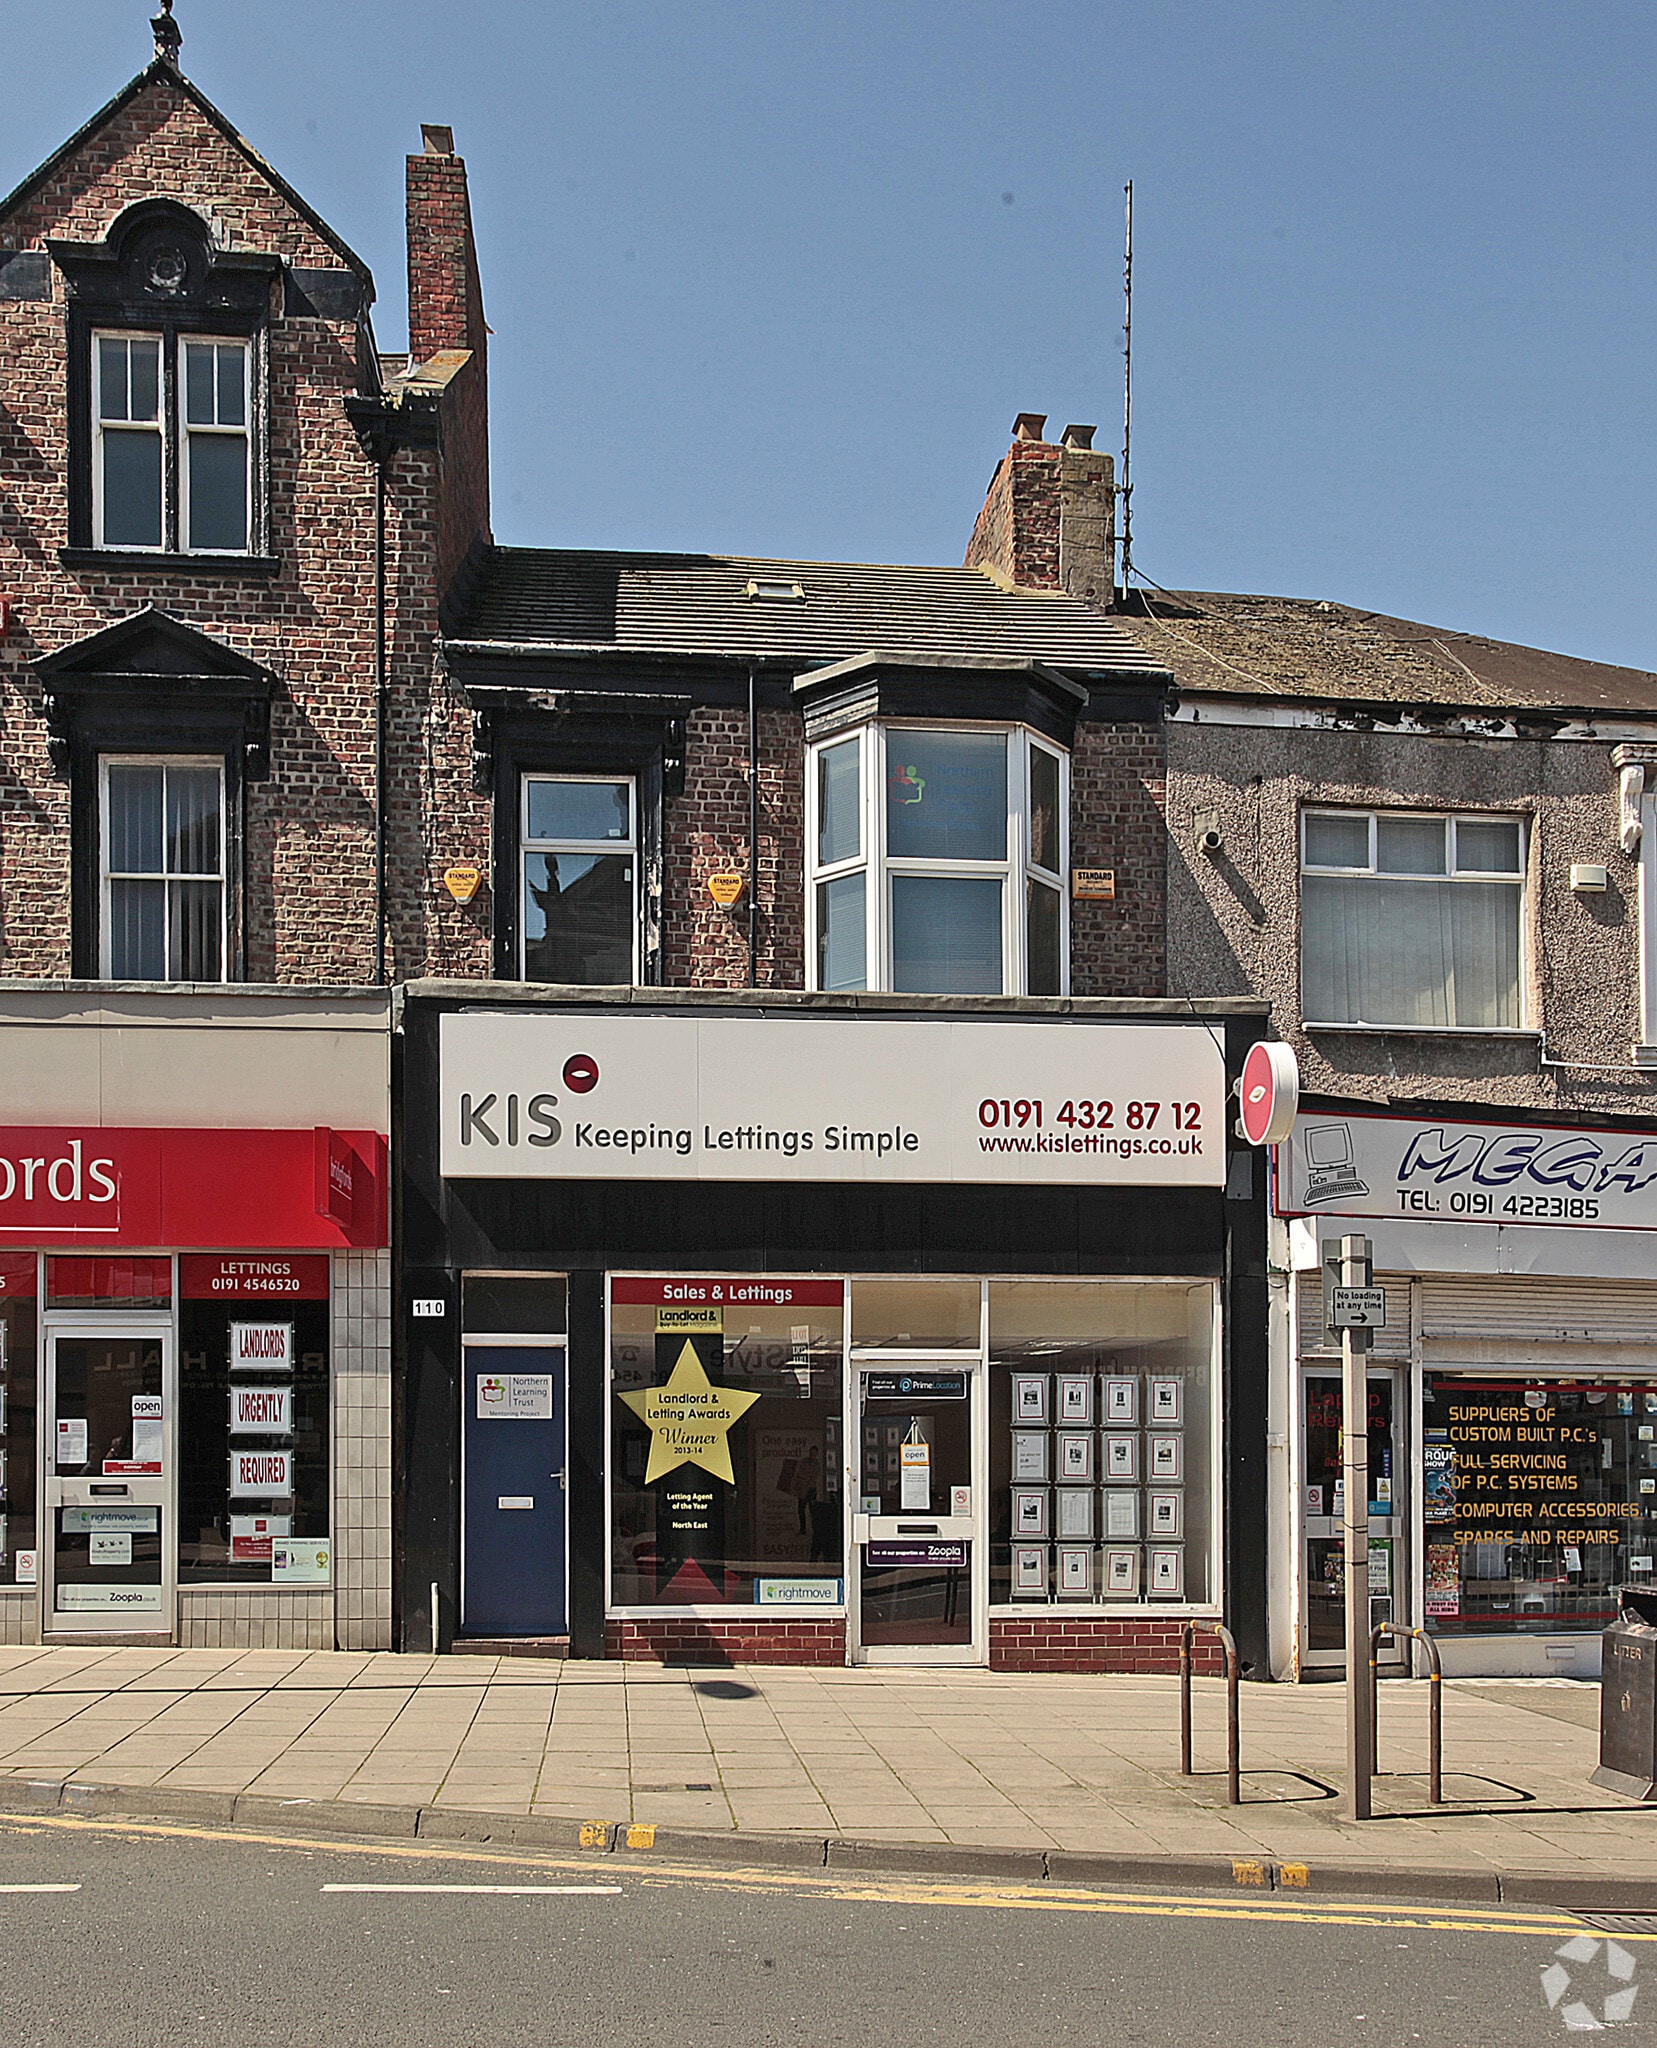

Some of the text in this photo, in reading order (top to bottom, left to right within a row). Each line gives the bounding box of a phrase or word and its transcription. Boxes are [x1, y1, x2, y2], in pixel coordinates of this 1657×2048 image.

[1078, 872, 1112, 880] STANDARD
[460, 1092, 564, 1148] KIS
[979, 1098, 1202, 1131] 0191 432 87 12
[575, 1122, 919, 1158] Keeping Lettings Simple
[979, 1131, 1204, 1160] www.kislettings.co.uk
[1396, 1189, 1600, 1219] TEL: 0191 4223185
[220, 1262, 291, 1275] LETTINGS
[211, 1277, 300, 1291] 0191 4546520
[663, 1284, 793, 1304] Sales & Lettings
[1337, 1290, 1381, 1302] No loading
[415, 1302, 443, 1314] 110
[1336, 1301, 1382, 1312] at any time
[660, 1310, 717, 1321] Landlord &
[239, 1329, 285, 1359] LANDLORDS
[513, 1377, 548, 1385] Northern
[513, 1388, 547, 1397] Learning
[658, 1393, 719, 1404] Landlord &
[134, 1402, 160, 1412] open
[238, 1393, 284, 1423] URGENTLY
[513, 1398, 534, 1406] Trust
[648, 1408, 731, 1420] Letting Awards
[1449, 1406, 1556, 1422] SUPPLIERS OF
[659, 1427, 719, 1445] Winner
[1450, 1426, 1597, 1443] CUSTOM BUILT P.C.'s
[905, 1451, 925, 1459] open
[1451, 1454, 1567, 1469] FULL SERVICING
[239, 1457, 285, 1486] REQUIRED
[1451, 1475, 1578, 1490] OF P.C. SYSTEMS
[667, 1492, 713, 1501] Letting Agent
[672, 1502, 708, 1510] of the Year
[1453, 1502, 1533, 1518] COMPUTER
[1538, 1502, 1640, 1518] ACCESSORIES
[672, 1521, 708, 1529] North East
[1453, 1530, 1620, 1546] SPARES AND REPAIRS
[927, 1545, 961, 1557] Zoopla
[778, 1587, 832, 1601] rightmove
